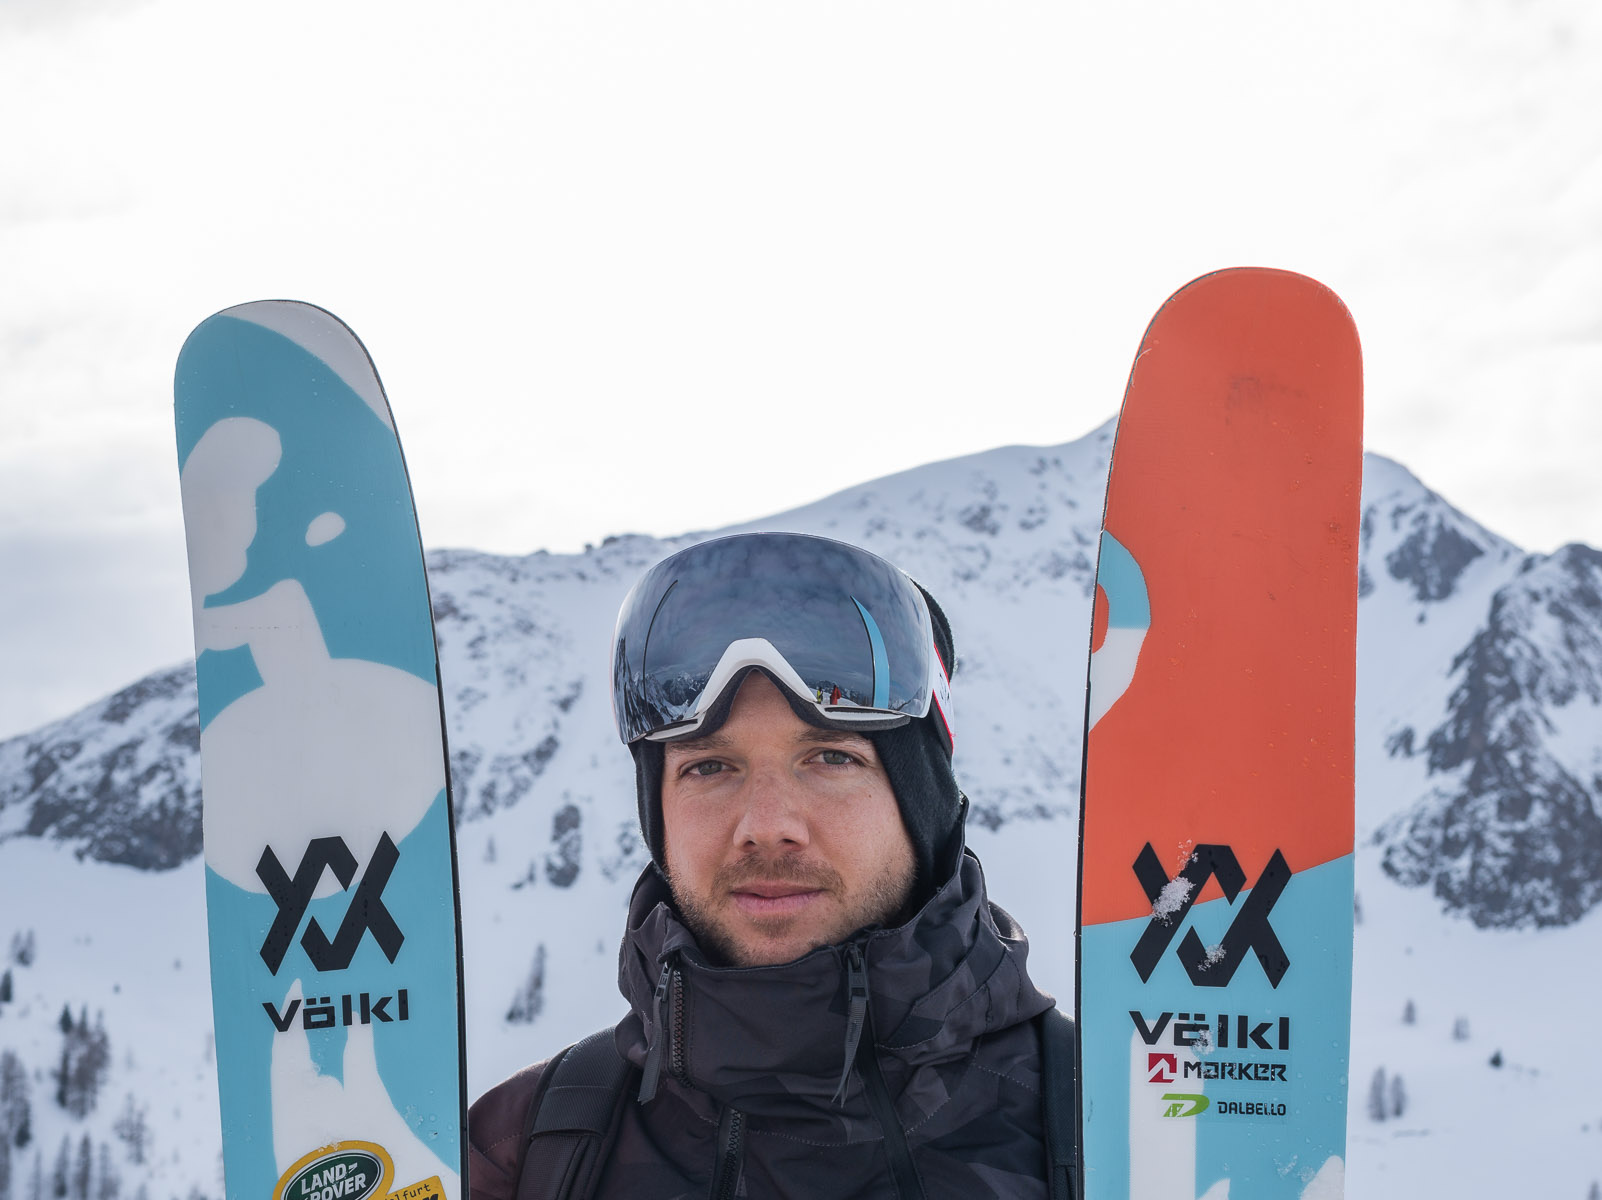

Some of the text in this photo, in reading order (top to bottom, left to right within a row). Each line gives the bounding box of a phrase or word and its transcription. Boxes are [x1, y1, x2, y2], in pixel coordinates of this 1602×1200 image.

[262, 989, 409, 1032] Völkl
[1183, 1060, 1288, 1082] MARKER
[1217, 1101, 1287, 1116] DALBELLO
[300, 1163, 348, 1194] LAND
